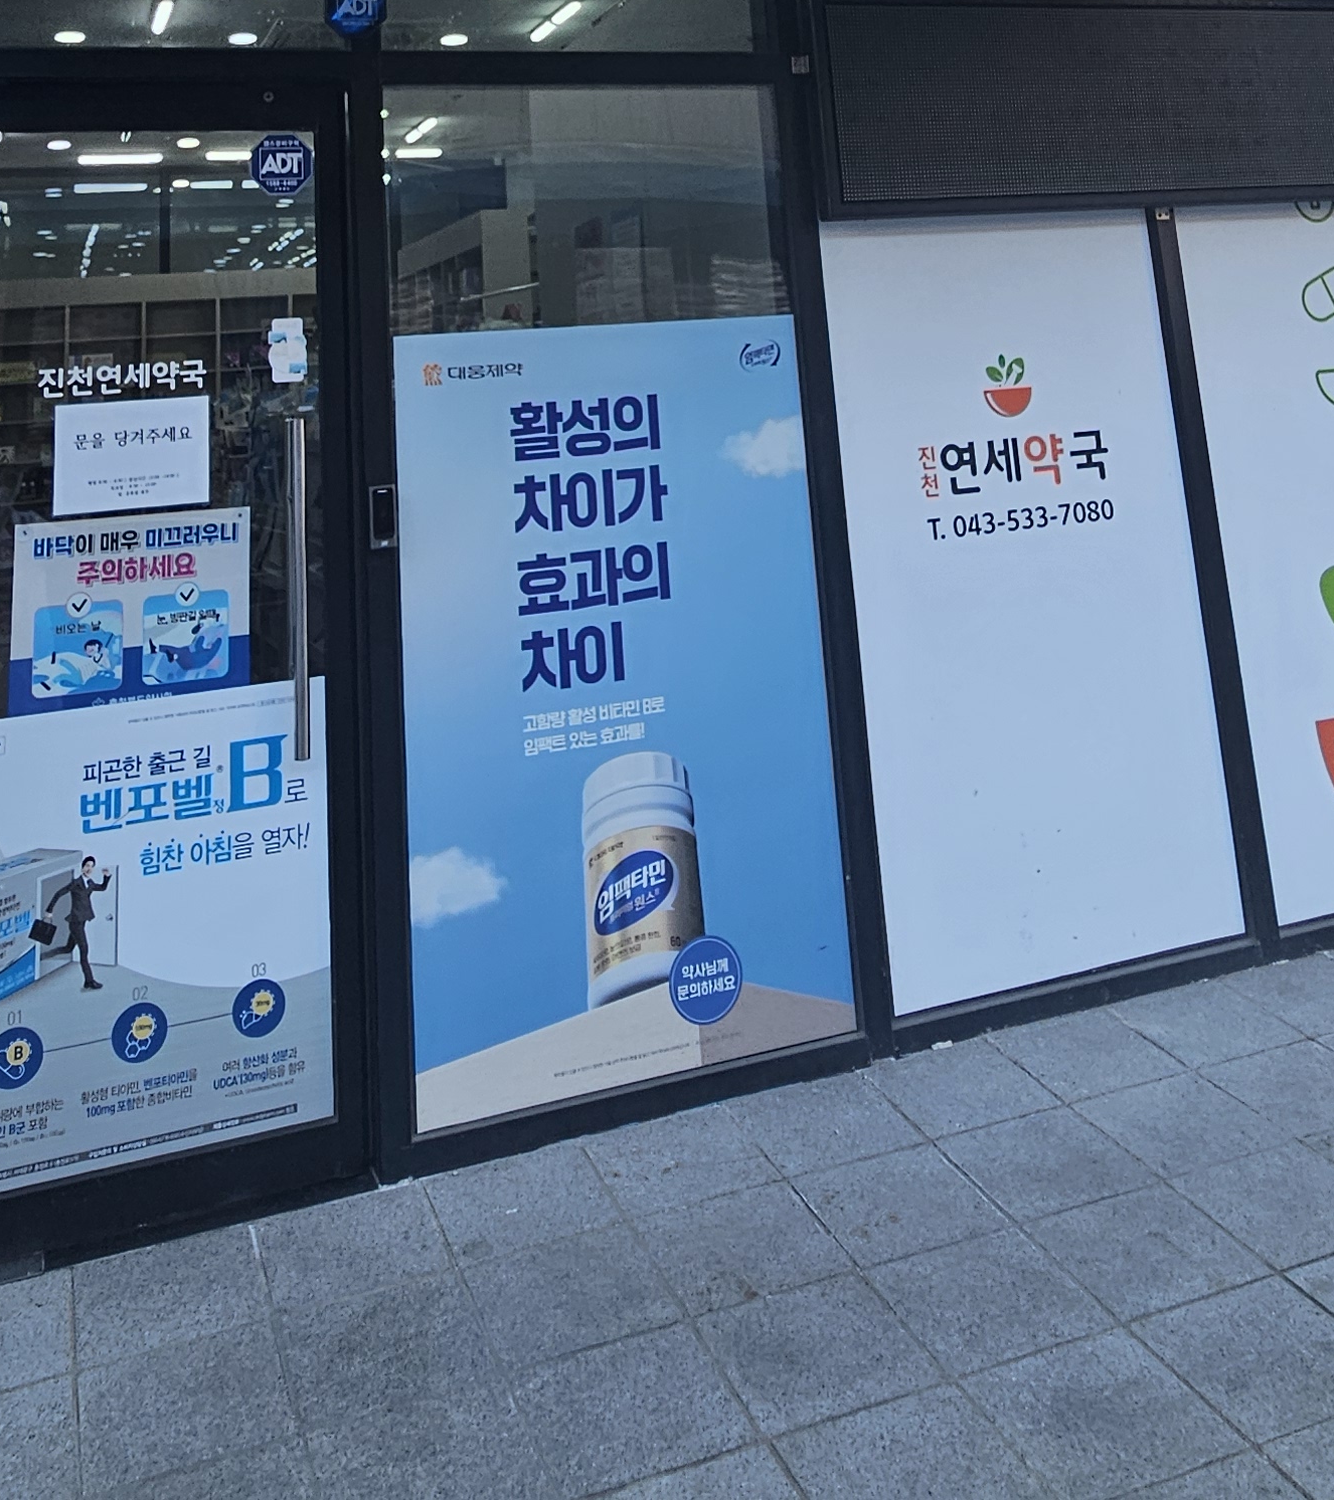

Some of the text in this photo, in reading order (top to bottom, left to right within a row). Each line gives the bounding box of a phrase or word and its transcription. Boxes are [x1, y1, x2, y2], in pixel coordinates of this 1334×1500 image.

[261, 152, 304, 175] ADT
[37, 359, 207, 399] 진천연세약국
[447, 362, 524, 380] 대웅제약
[74, 426, 193, 451] 문을 당겨주세요
[509, 393, 662, 462] 활성의
[939, 430, 1109, 496] 연세약국
[513, 464, 669, 534] 차이가
[927, 498, 1115, 541] T. 043-533-7080
[33, 522, 239, 559] 바닥이 매우 미끄러우니
[77, 552, 197, 586] 주의하세요
[517, 540, 672, 617] 효과의
[55, 620, 102, 635] 비오는 날
[521, 620, 626, 693] 차이
[523, 711, 566, 734] 고함량
[568, 705, 597, 726] 활성
[598, 698, 641, 722] 비타민
[523, 732, 567, 756] 임팩트
[569, 727, 598, 750] 있는
[82, 745, 212, 784] 피곤한 출근 길
[79, 772, 216, 835] 벤포벨
[226, 733, 289, 814] B
[284, 778, 309, 805] 로
[139, 822, 311, 876] 힘찬 아침을 열자!
[597, 858, 667, 925] 임팩타민
[251, 962, 267, 978] 03
[681, 957, 730, 980] 약사님께
[132, 985, 149, 1001] 02
[676, 975, 737, 1002] 문의하세요
[6, 1010, 23, 1026] 01
[13, 1045, 23, 1061] B
[222, 1058, 241, 1073] 여러
[80, 1087, 109, 1105] 활성형
[143, 1067, 198, 1091] 벤포티아민을
[86, 1085, 193, 1118] 100mg 포함한 종합비타민
[9, 1121, 25, 1135] B군
[27, 1116, 48, 1131] 포함
